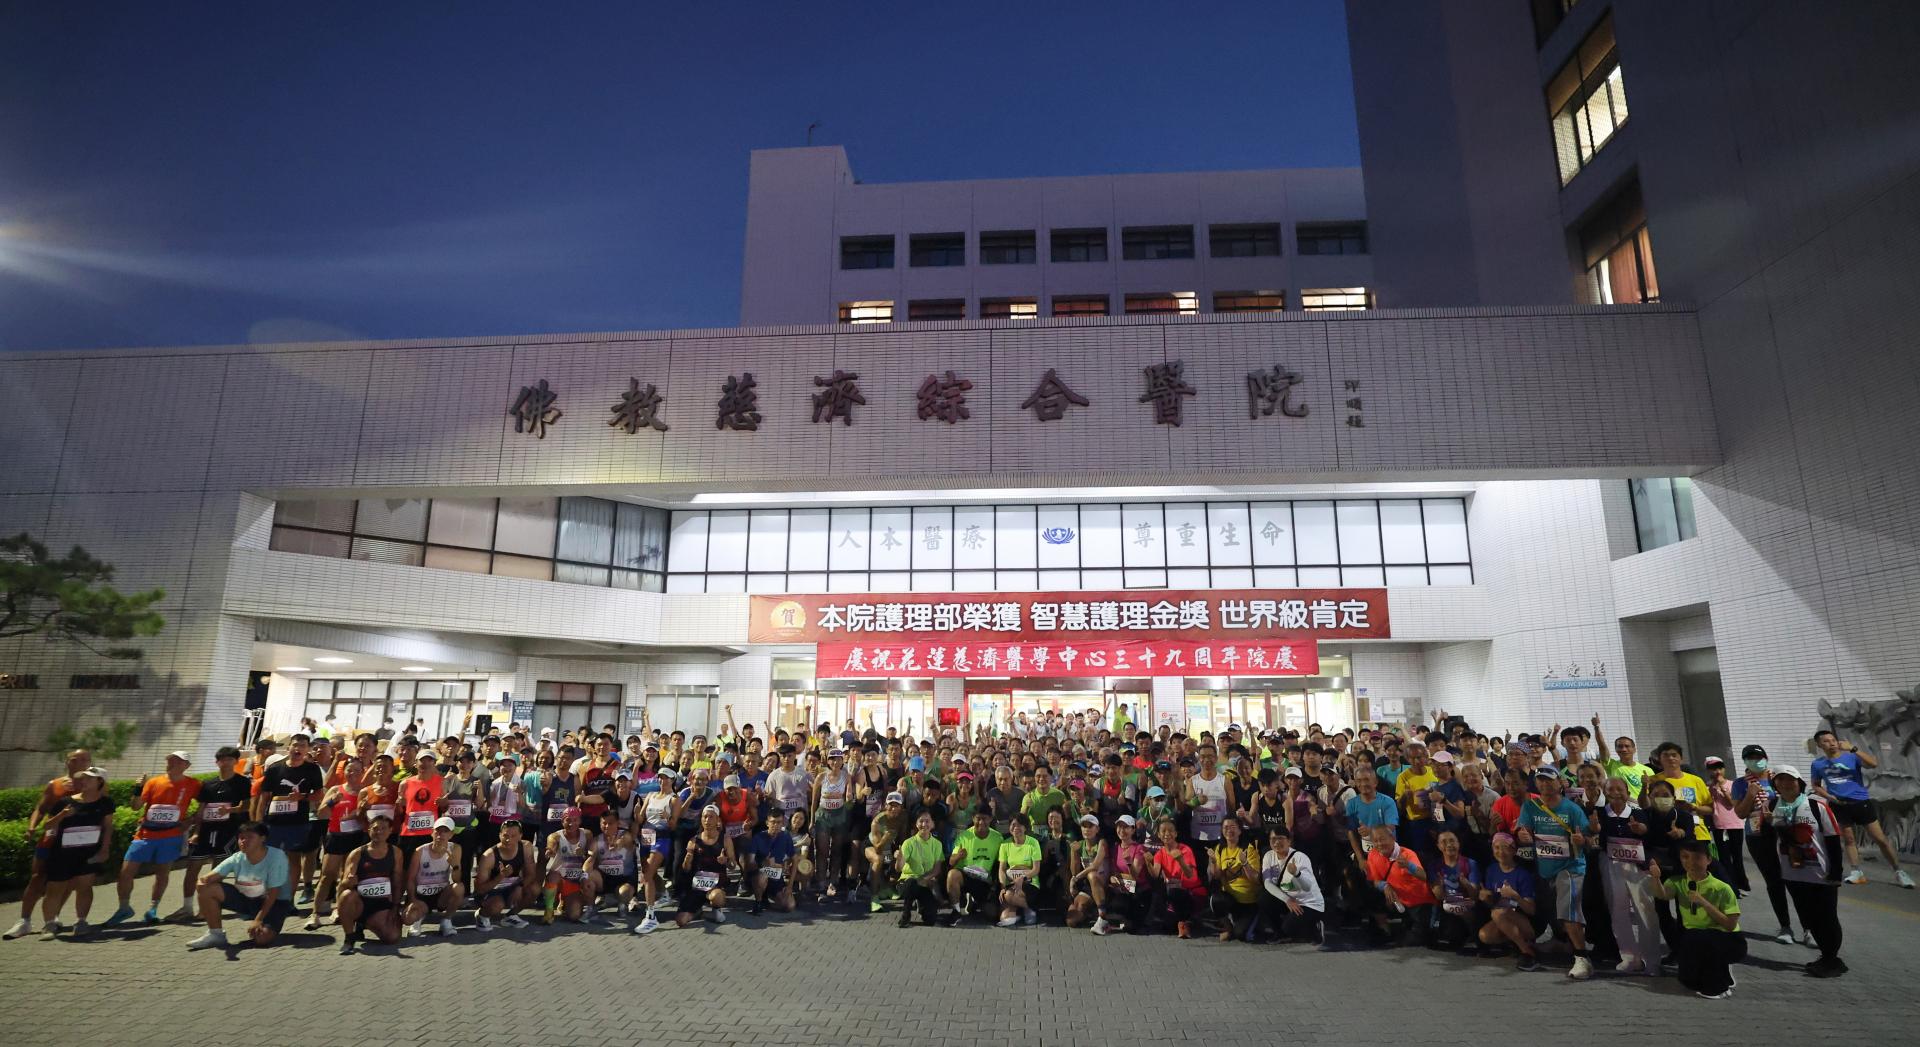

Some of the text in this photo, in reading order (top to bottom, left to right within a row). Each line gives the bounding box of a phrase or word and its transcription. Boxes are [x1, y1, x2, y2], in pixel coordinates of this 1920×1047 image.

[509, 359, 1309, 439] 佛教慈濟綜合醫院
[838, 524, 988, 551] 人本醫療
[1133, 520, 1286, 548] 尊重生命
[780, 608, 795, 626] 賀
[817, 599, 1371, 633] 本院護理部榮獲 智慧護理金獎 世界級肯定
[843, 645, 1298, 674] 慶祝花蓮慈濟醫學中心三十九周年院慶
[151, 812, 174, 821] 2052
[411, 819, 431, 828] 2069
[1540, 844, 1563, 855] 2064
[1612, 849, 1638, 858] 2002
[363, 887, 386, 896] 2025
